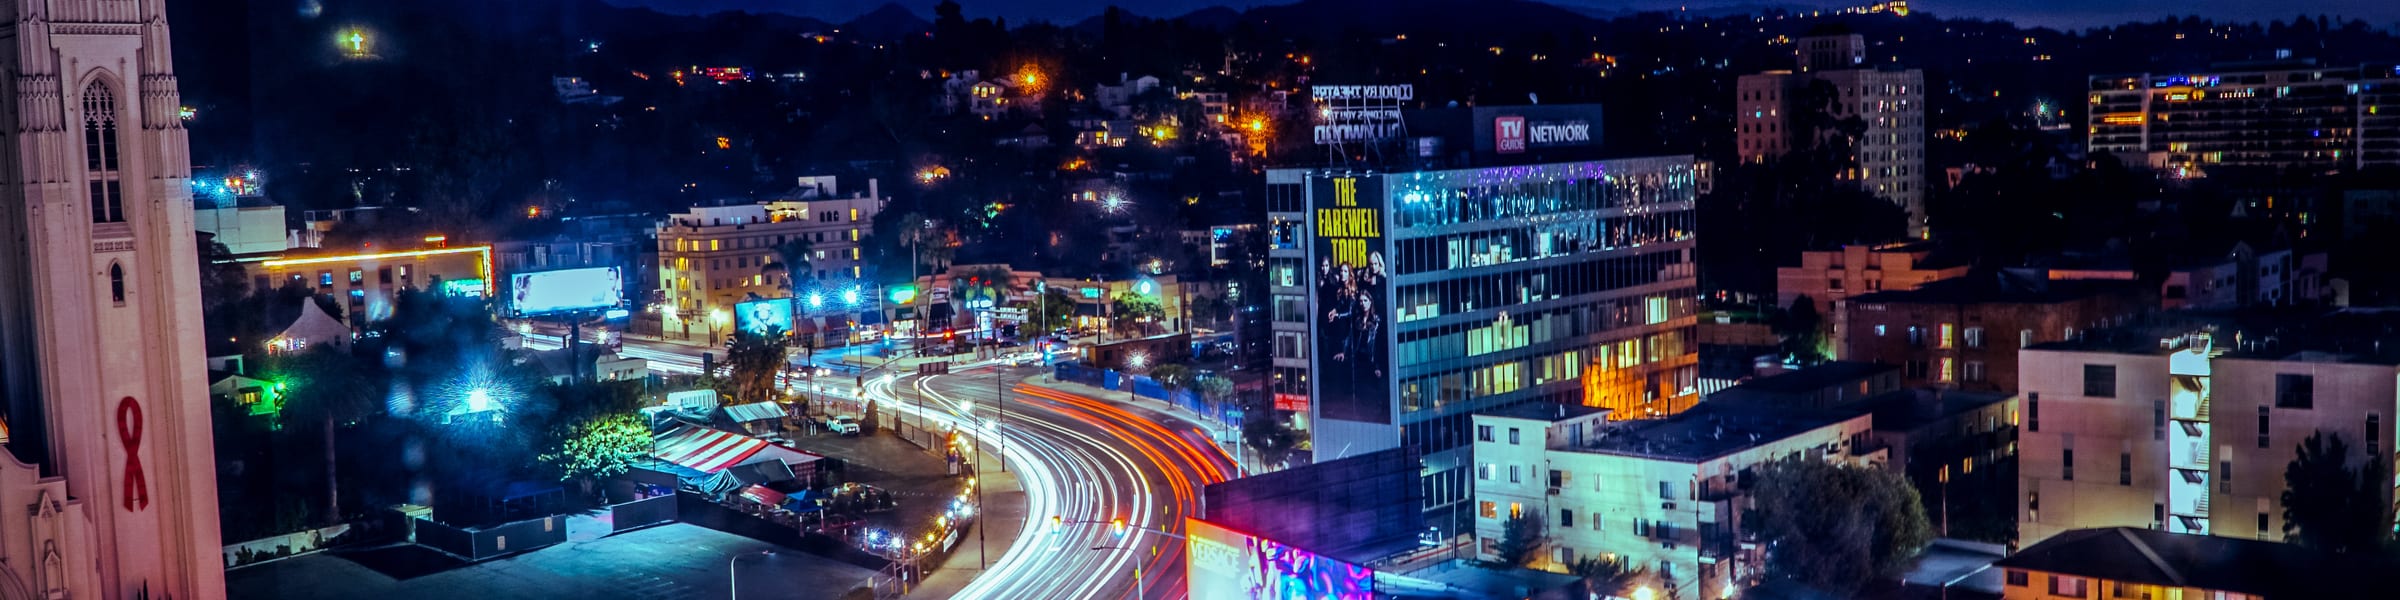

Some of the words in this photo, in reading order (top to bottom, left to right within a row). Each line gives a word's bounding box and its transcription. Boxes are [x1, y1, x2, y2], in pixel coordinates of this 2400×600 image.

[1501, 121, 1521, 138] TV
[1530, 124, 1589, 143] NETWORK
[1501, 139, 1524, 151] GUIDE
[1333, 177, 1357, 206] THE
[1317, 208, 1380, 237] FAREWELL
[1331, 238, 1367, 268] TOUR
[1190, 540, 1240, 573] VERSACE
